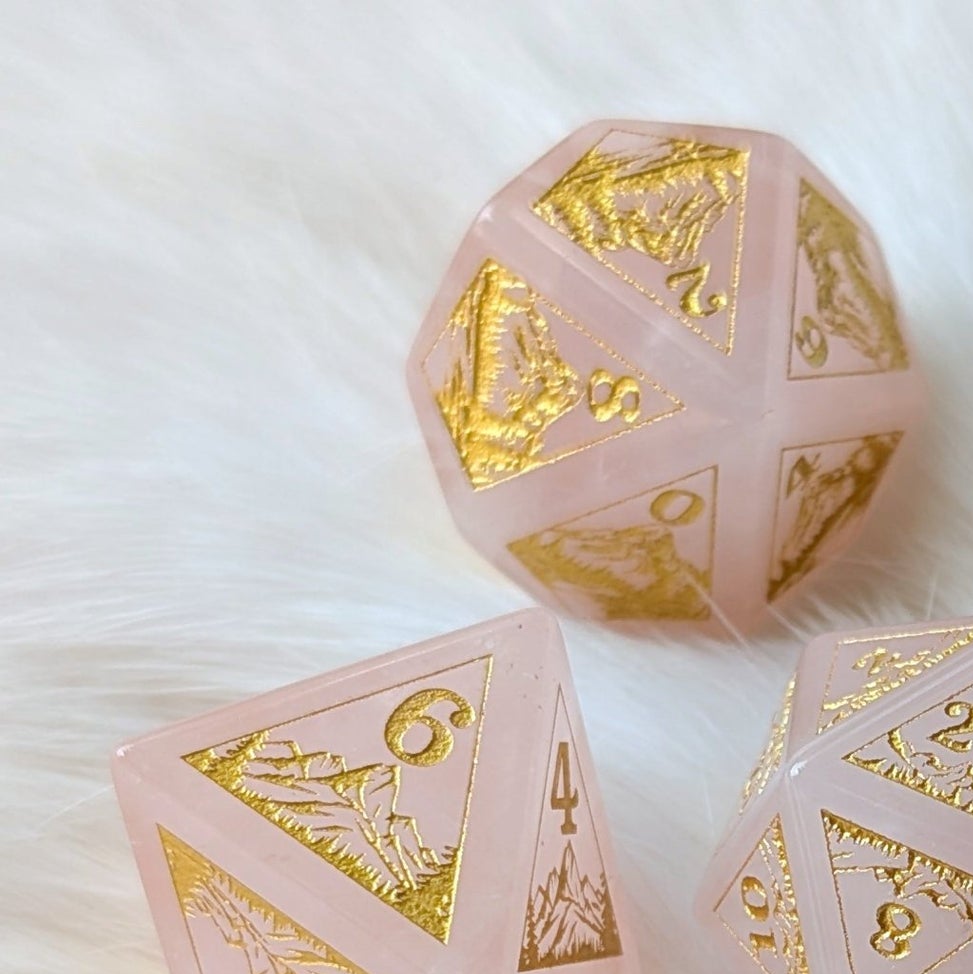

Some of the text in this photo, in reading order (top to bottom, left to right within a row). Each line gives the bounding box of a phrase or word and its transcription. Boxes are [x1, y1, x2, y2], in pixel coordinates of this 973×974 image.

[665, 262, 728, 318] 2
[587, 368, 641, 424] 8
[649, 488, 704, 526] 0
[384, 687, 476, 767] 6
[550, 741, 579, 835] 4
[741, 875, 779, 959] 10
[870, 901, 921, 960] 8
